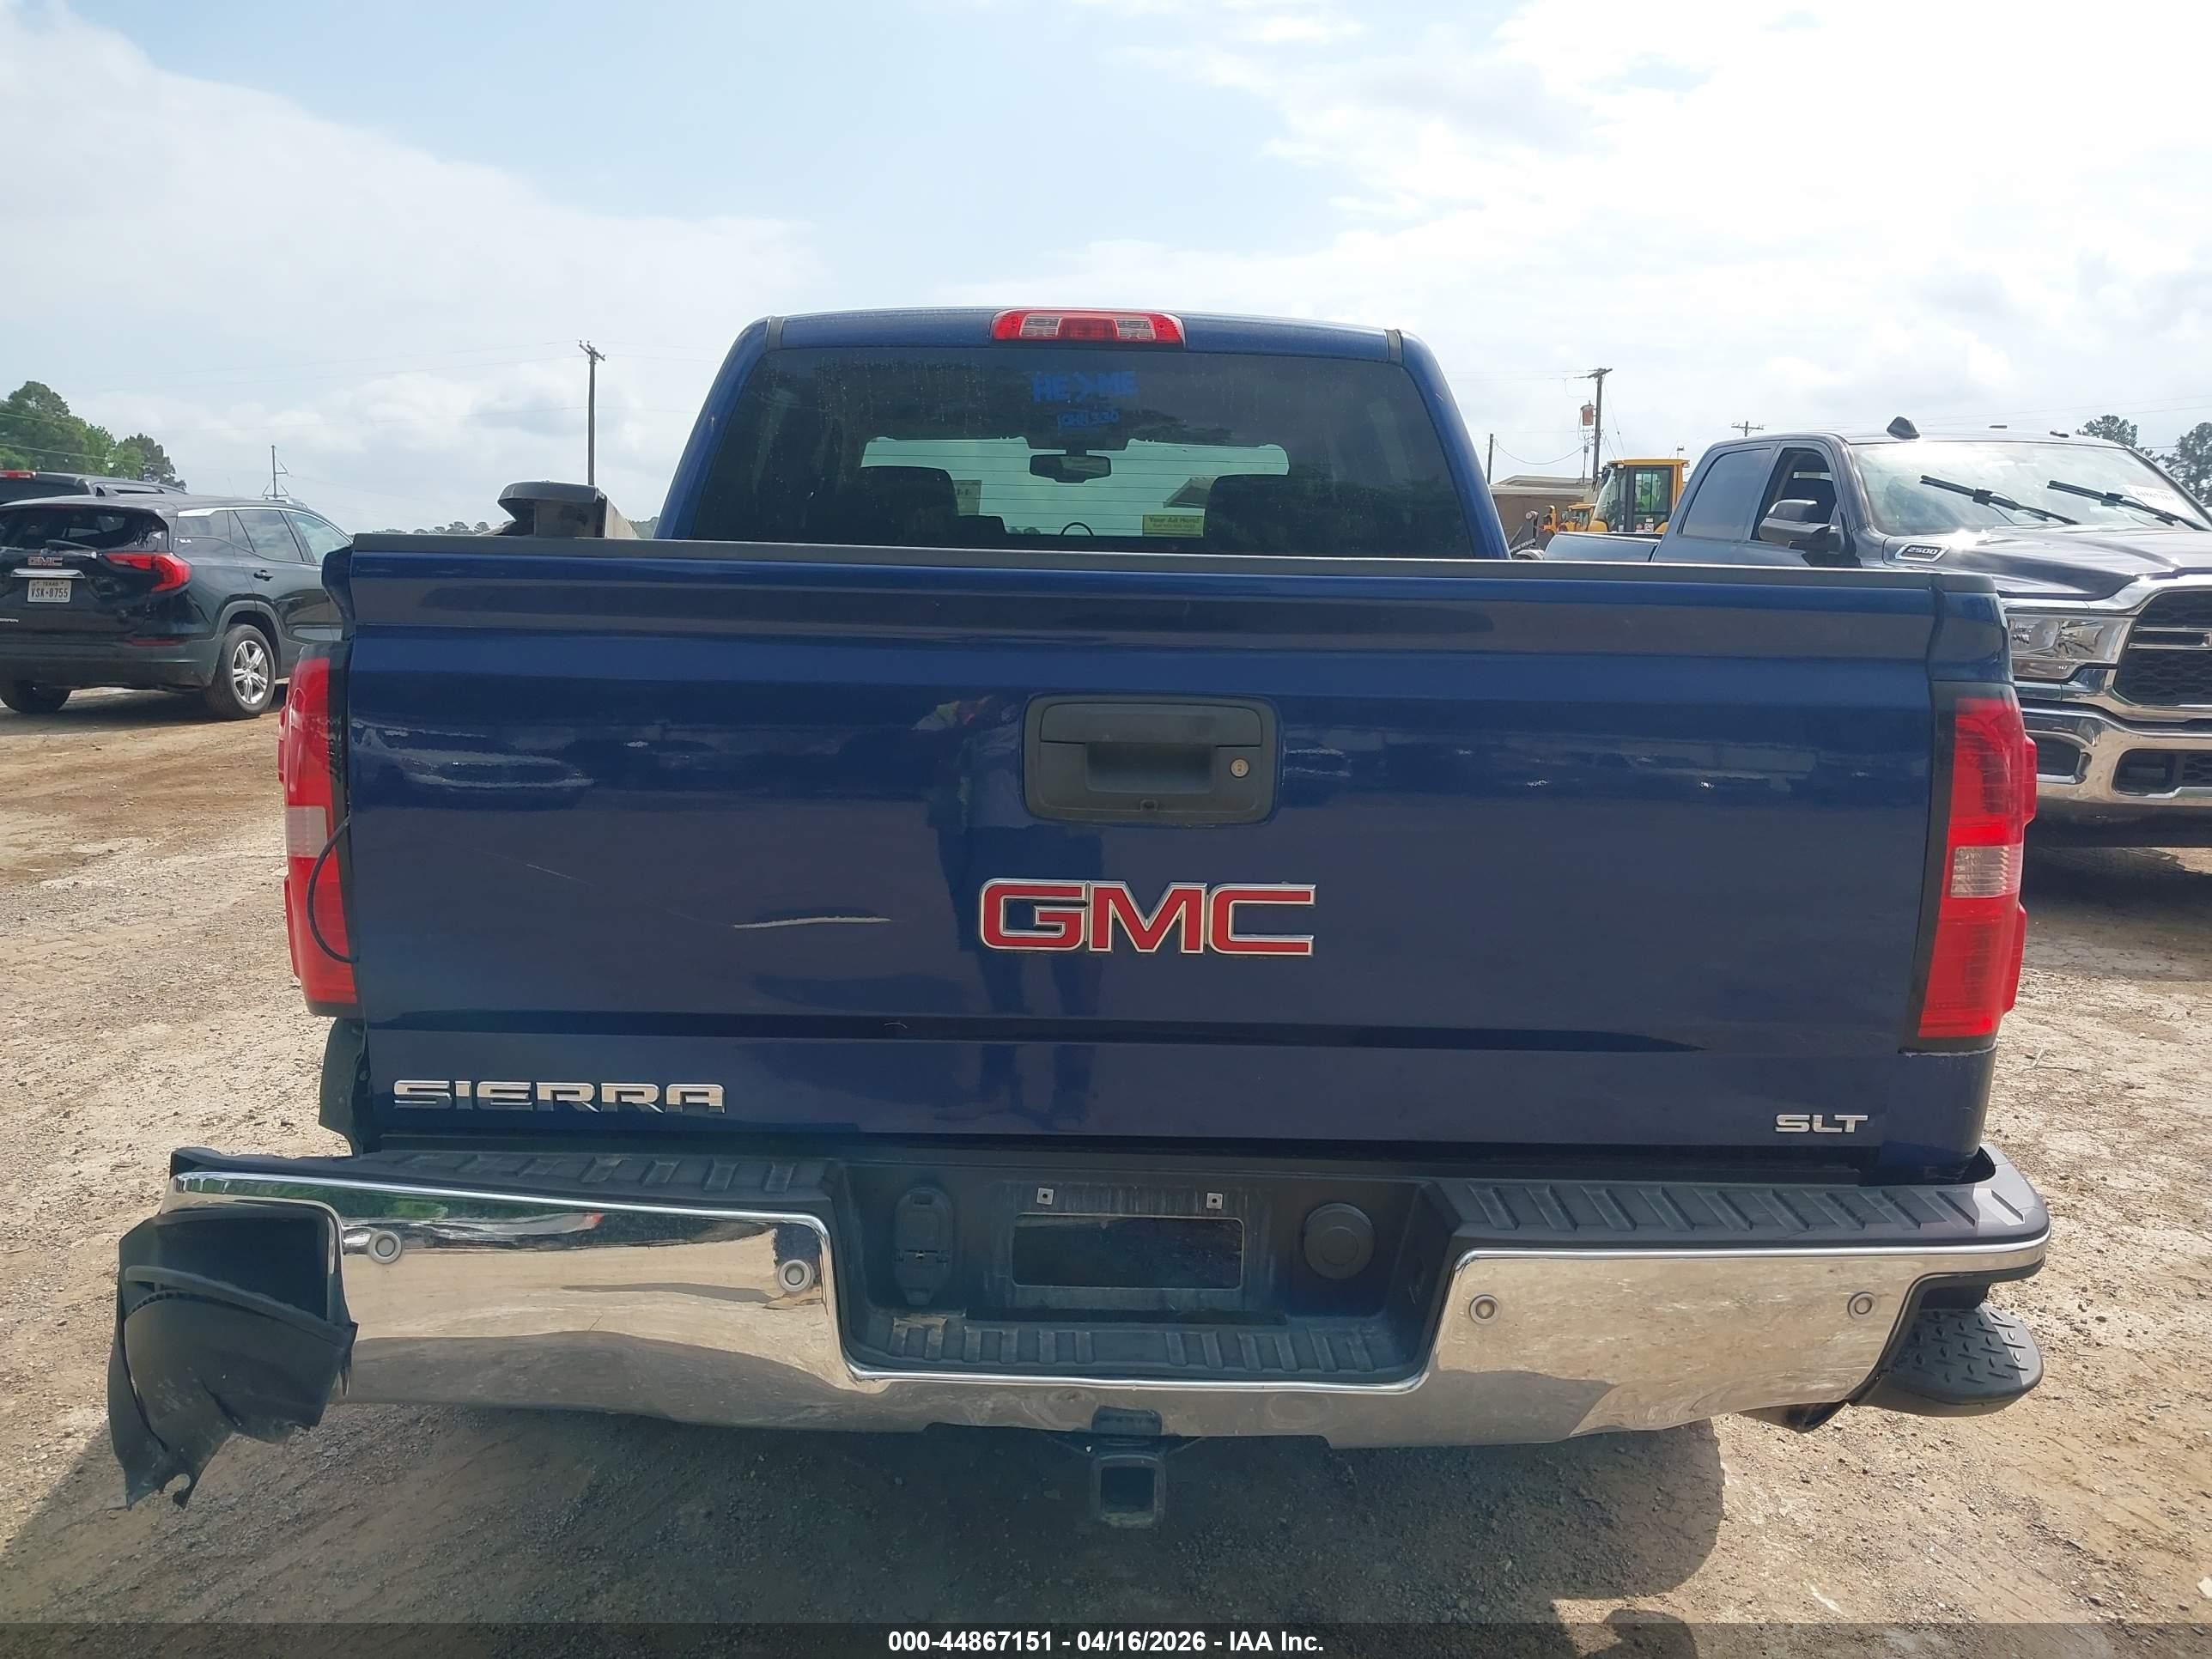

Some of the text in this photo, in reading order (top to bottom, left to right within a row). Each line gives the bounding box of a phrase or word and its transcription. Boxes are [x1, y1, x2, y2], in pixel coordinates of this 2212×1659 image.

[1907, 546, 1938, 555] 2500
[27, 556, 64, 567] GMC
[980, 878, 1316, 957] GMC
[393, 1079, 726, 1114] SIERRA
[1775, 1115, 1869, 1133] SLT
